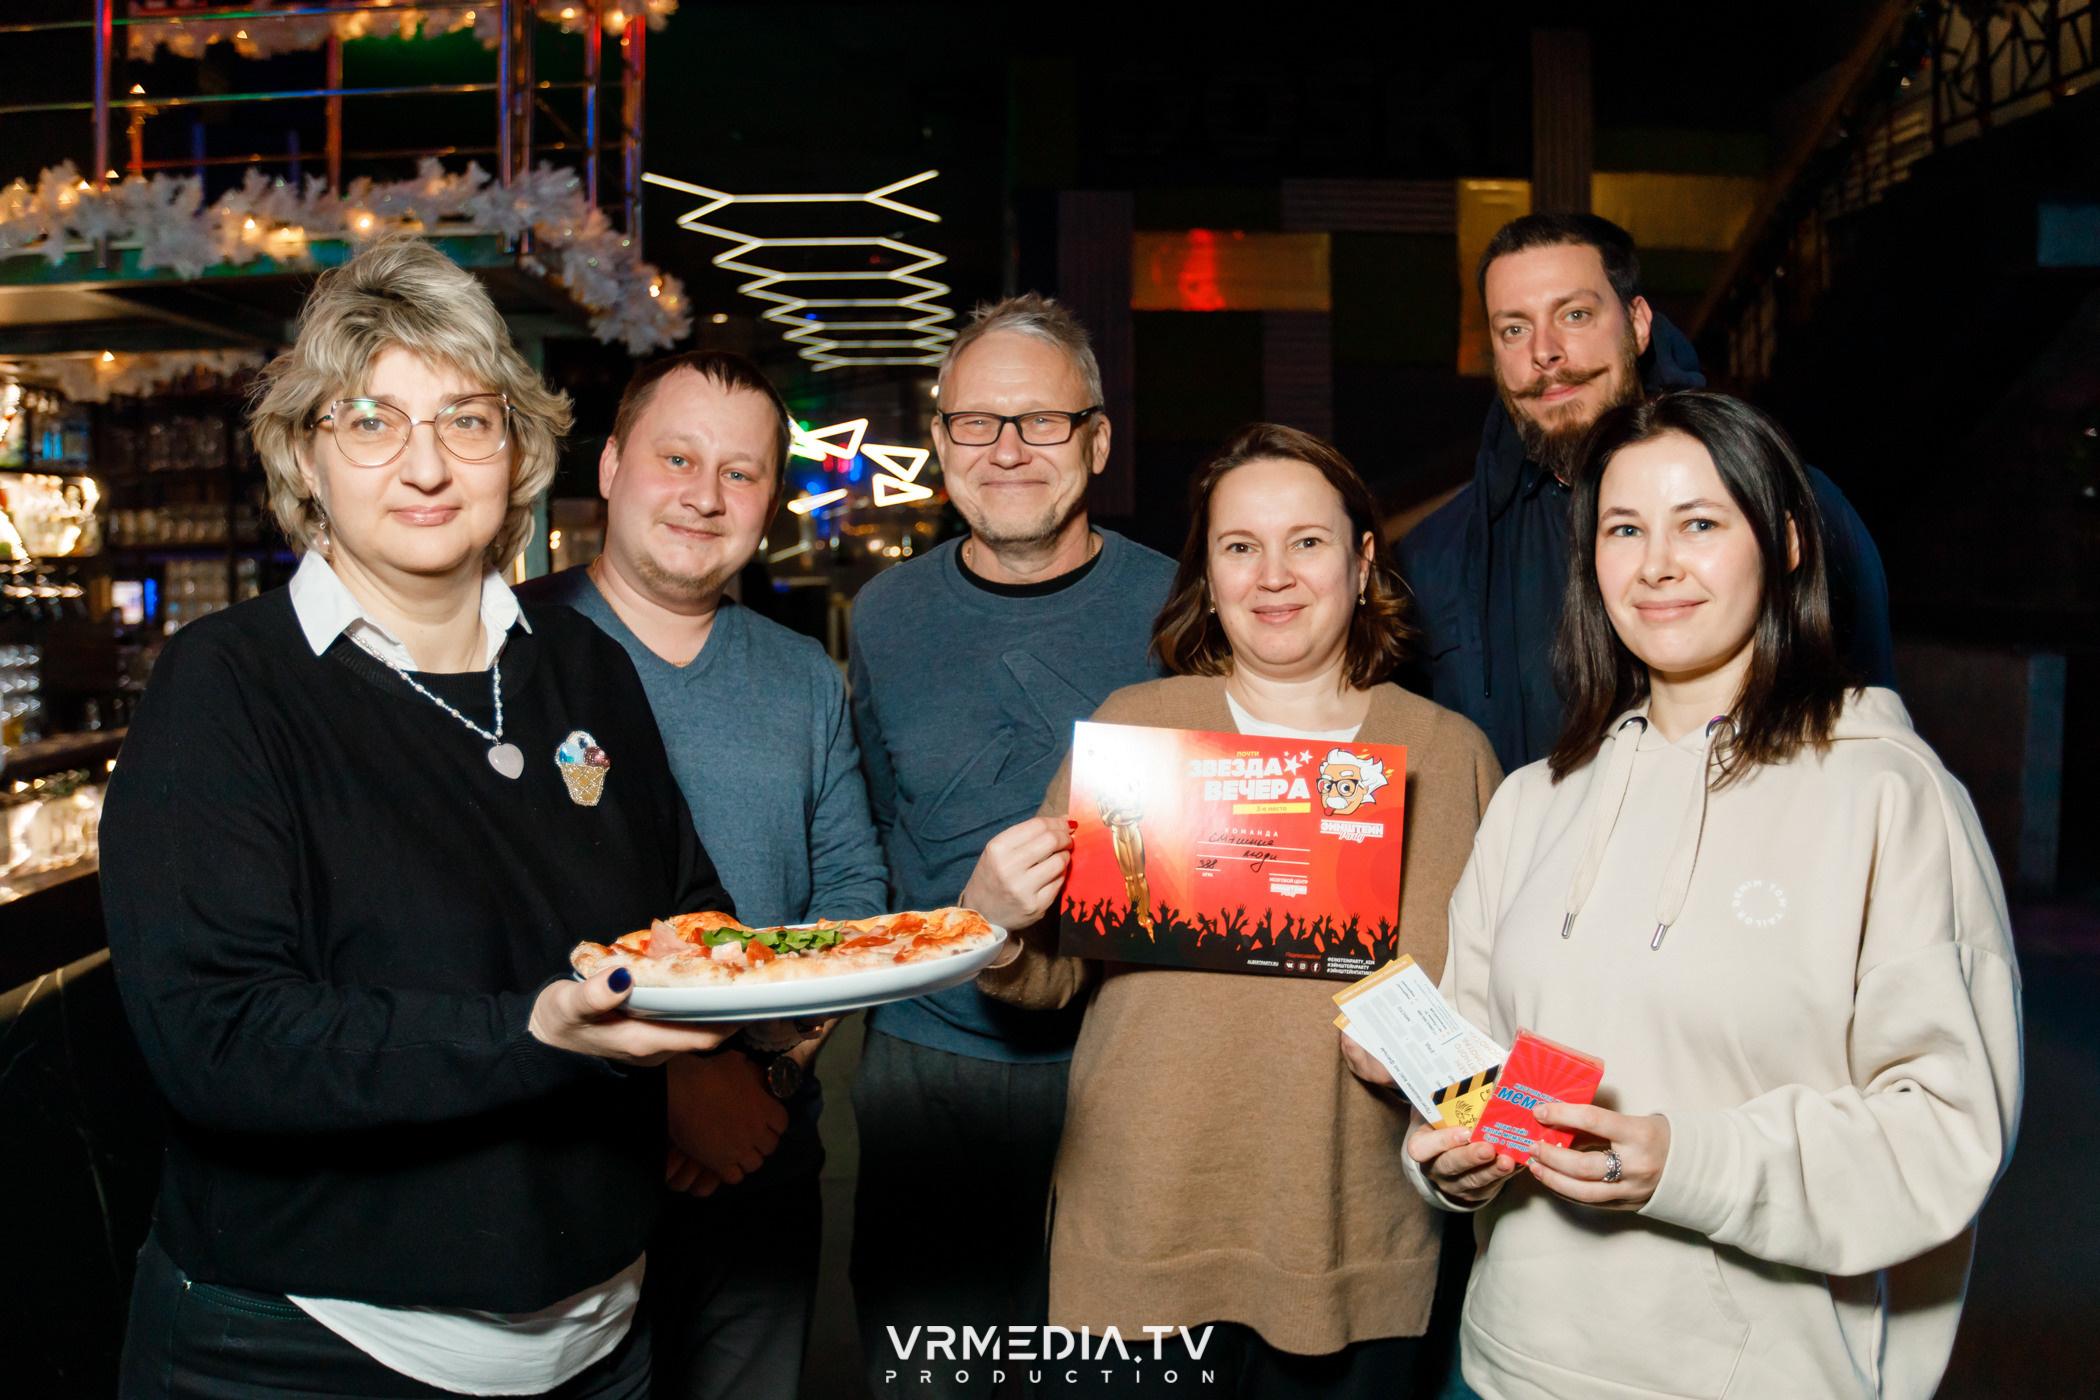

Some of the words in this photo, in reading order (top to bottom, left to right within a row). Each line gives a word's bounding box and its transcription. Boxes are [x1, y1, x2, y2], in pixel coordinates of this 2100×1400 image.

[1236, 750, 1260, 758] ПОЧТИ
[1188, 757, 1283, 778] ЗВЕЗДА
[1204, 778, 1310, 801] ВЕЧЕРА
[1225, 827, 1279, 838] КОМАНДА
[1497, 1086, 1546, 1110] мем
